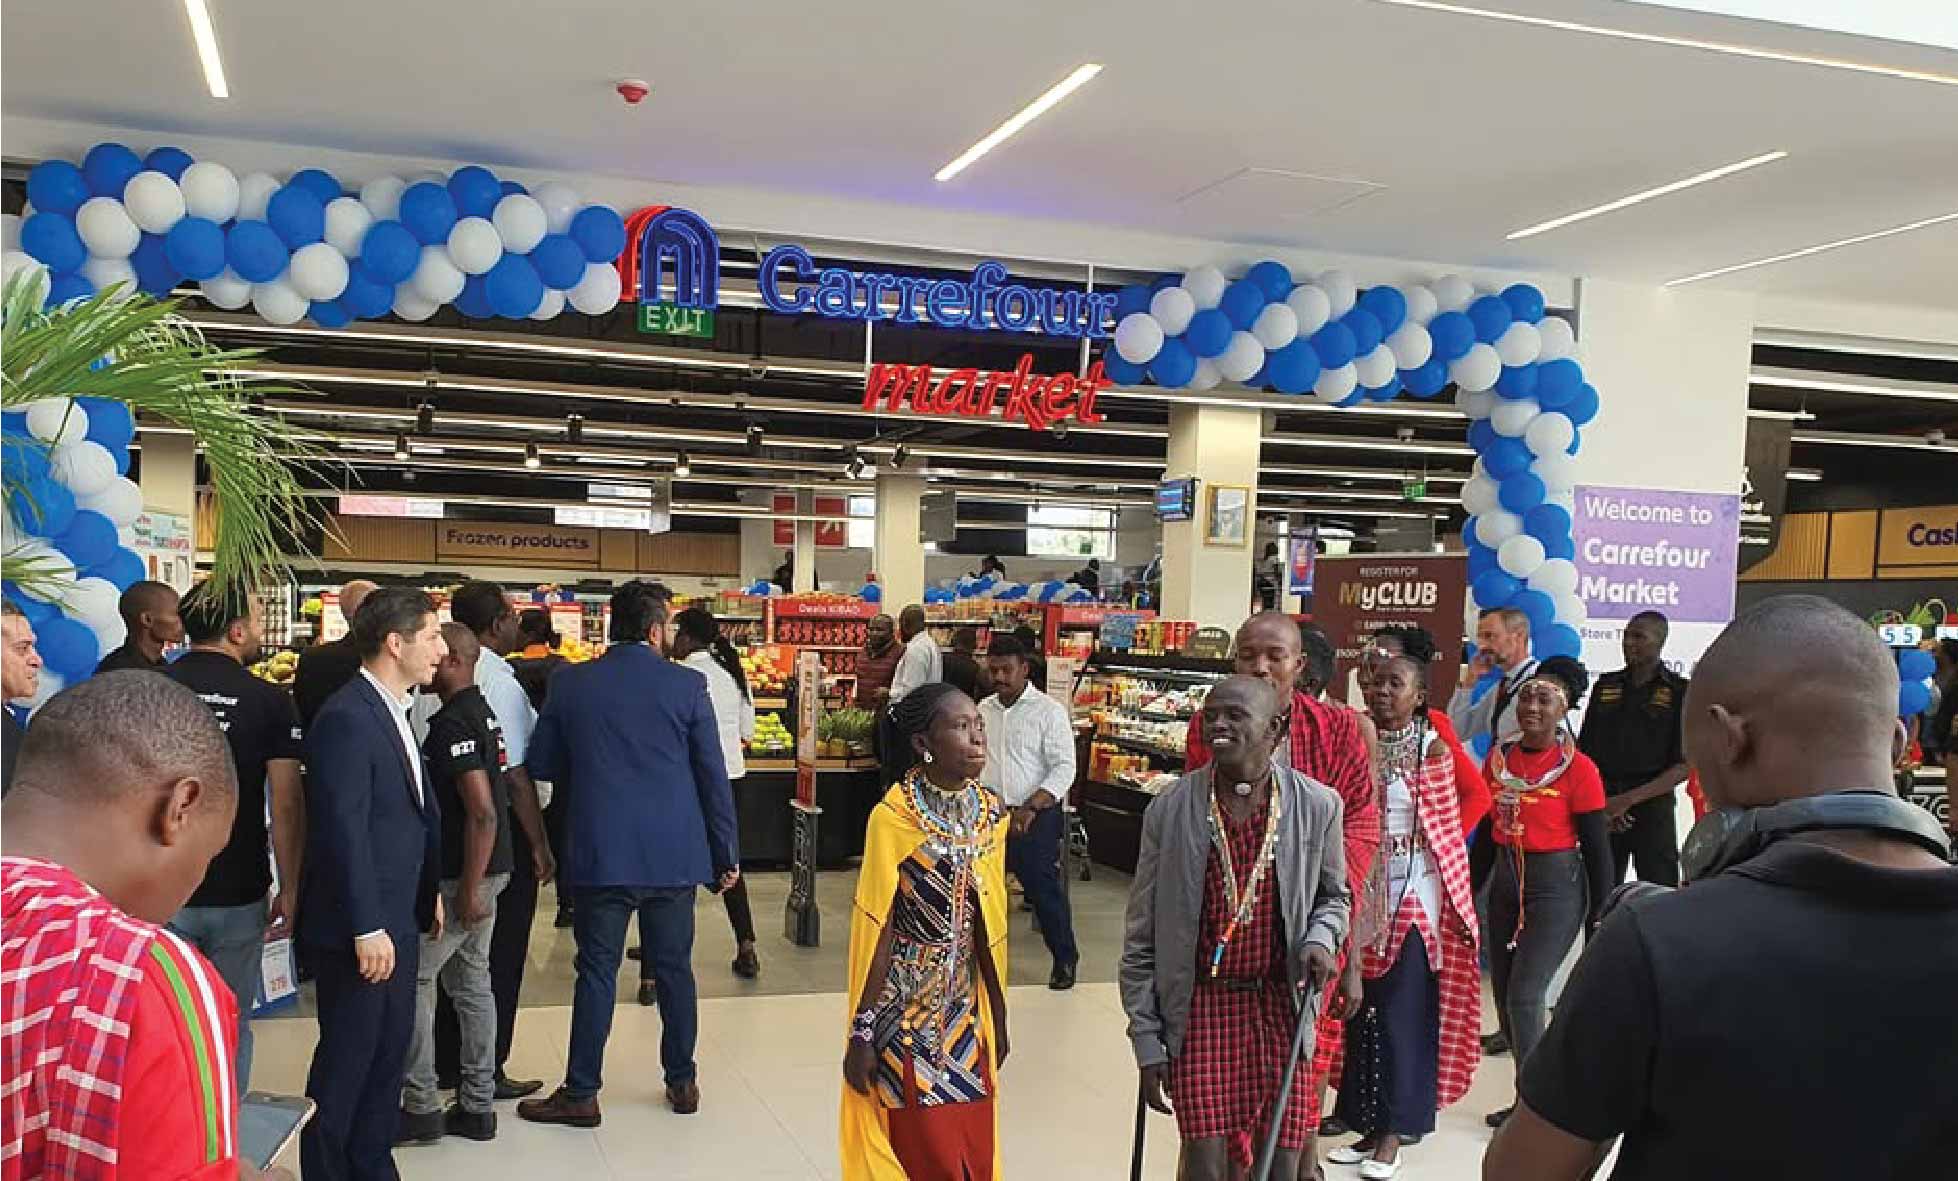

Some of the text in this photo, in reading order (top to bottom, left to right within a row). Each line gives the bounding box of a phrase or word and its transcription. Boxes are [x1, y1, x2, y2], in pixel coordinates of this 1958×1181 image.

[758, 245, 1117, 338] Carrefour
[646, 305, 706, 332] EXIT
[863, 353, 1112, 431] market
[1584, 496, 1683, 524] Welcome
[1690, 504, 1713, 525] to
[446, 528, 590, 549] Frozen products
[1583, 538, 1712, 569] Carrefour
[1339, 582, 1439, 610] MyCLUB
[1581, 576, 1680, 605] Market
